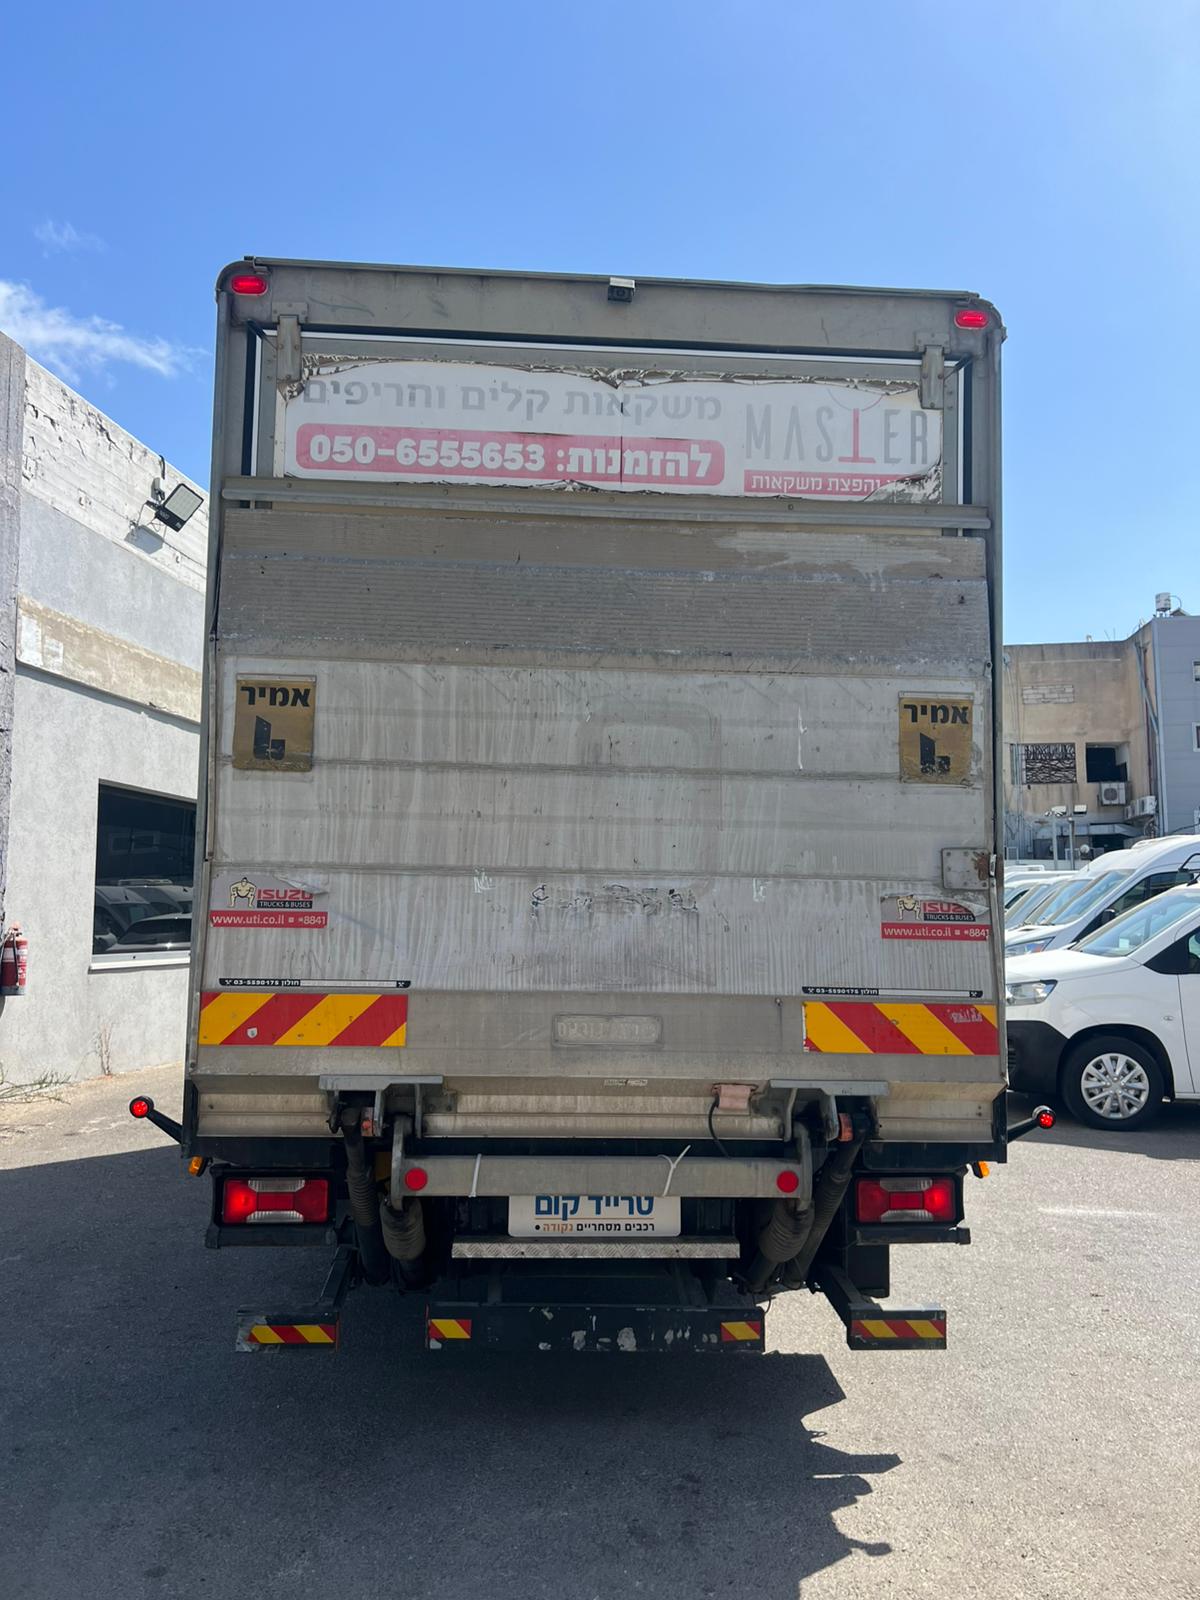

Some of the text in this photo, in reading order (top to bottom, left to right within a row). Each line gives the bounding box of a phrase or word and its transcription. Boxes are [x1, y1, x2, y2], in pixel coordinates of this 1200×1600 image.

[302, 379, 722, 426] משקאות קלים וחריפים
[745, 403, 929, 465] MASTER
[309, 434, 712, 478] להזמנות: 050-6555653
[751, 474, 823, 494] משקאות
[240, 686, 311, 708] אמיר
[903, 704, 969, 725] אמיר
[923, 902, 971, 913] ISUZ
[212, 914, 285, 925] www.uti.co.il
[884, 927, 952, 937] www.uti.co.il
[535, 1196, 581, 1221] קום
[543, 1223, 655, 1234] רכבים מסחריים נקודה
